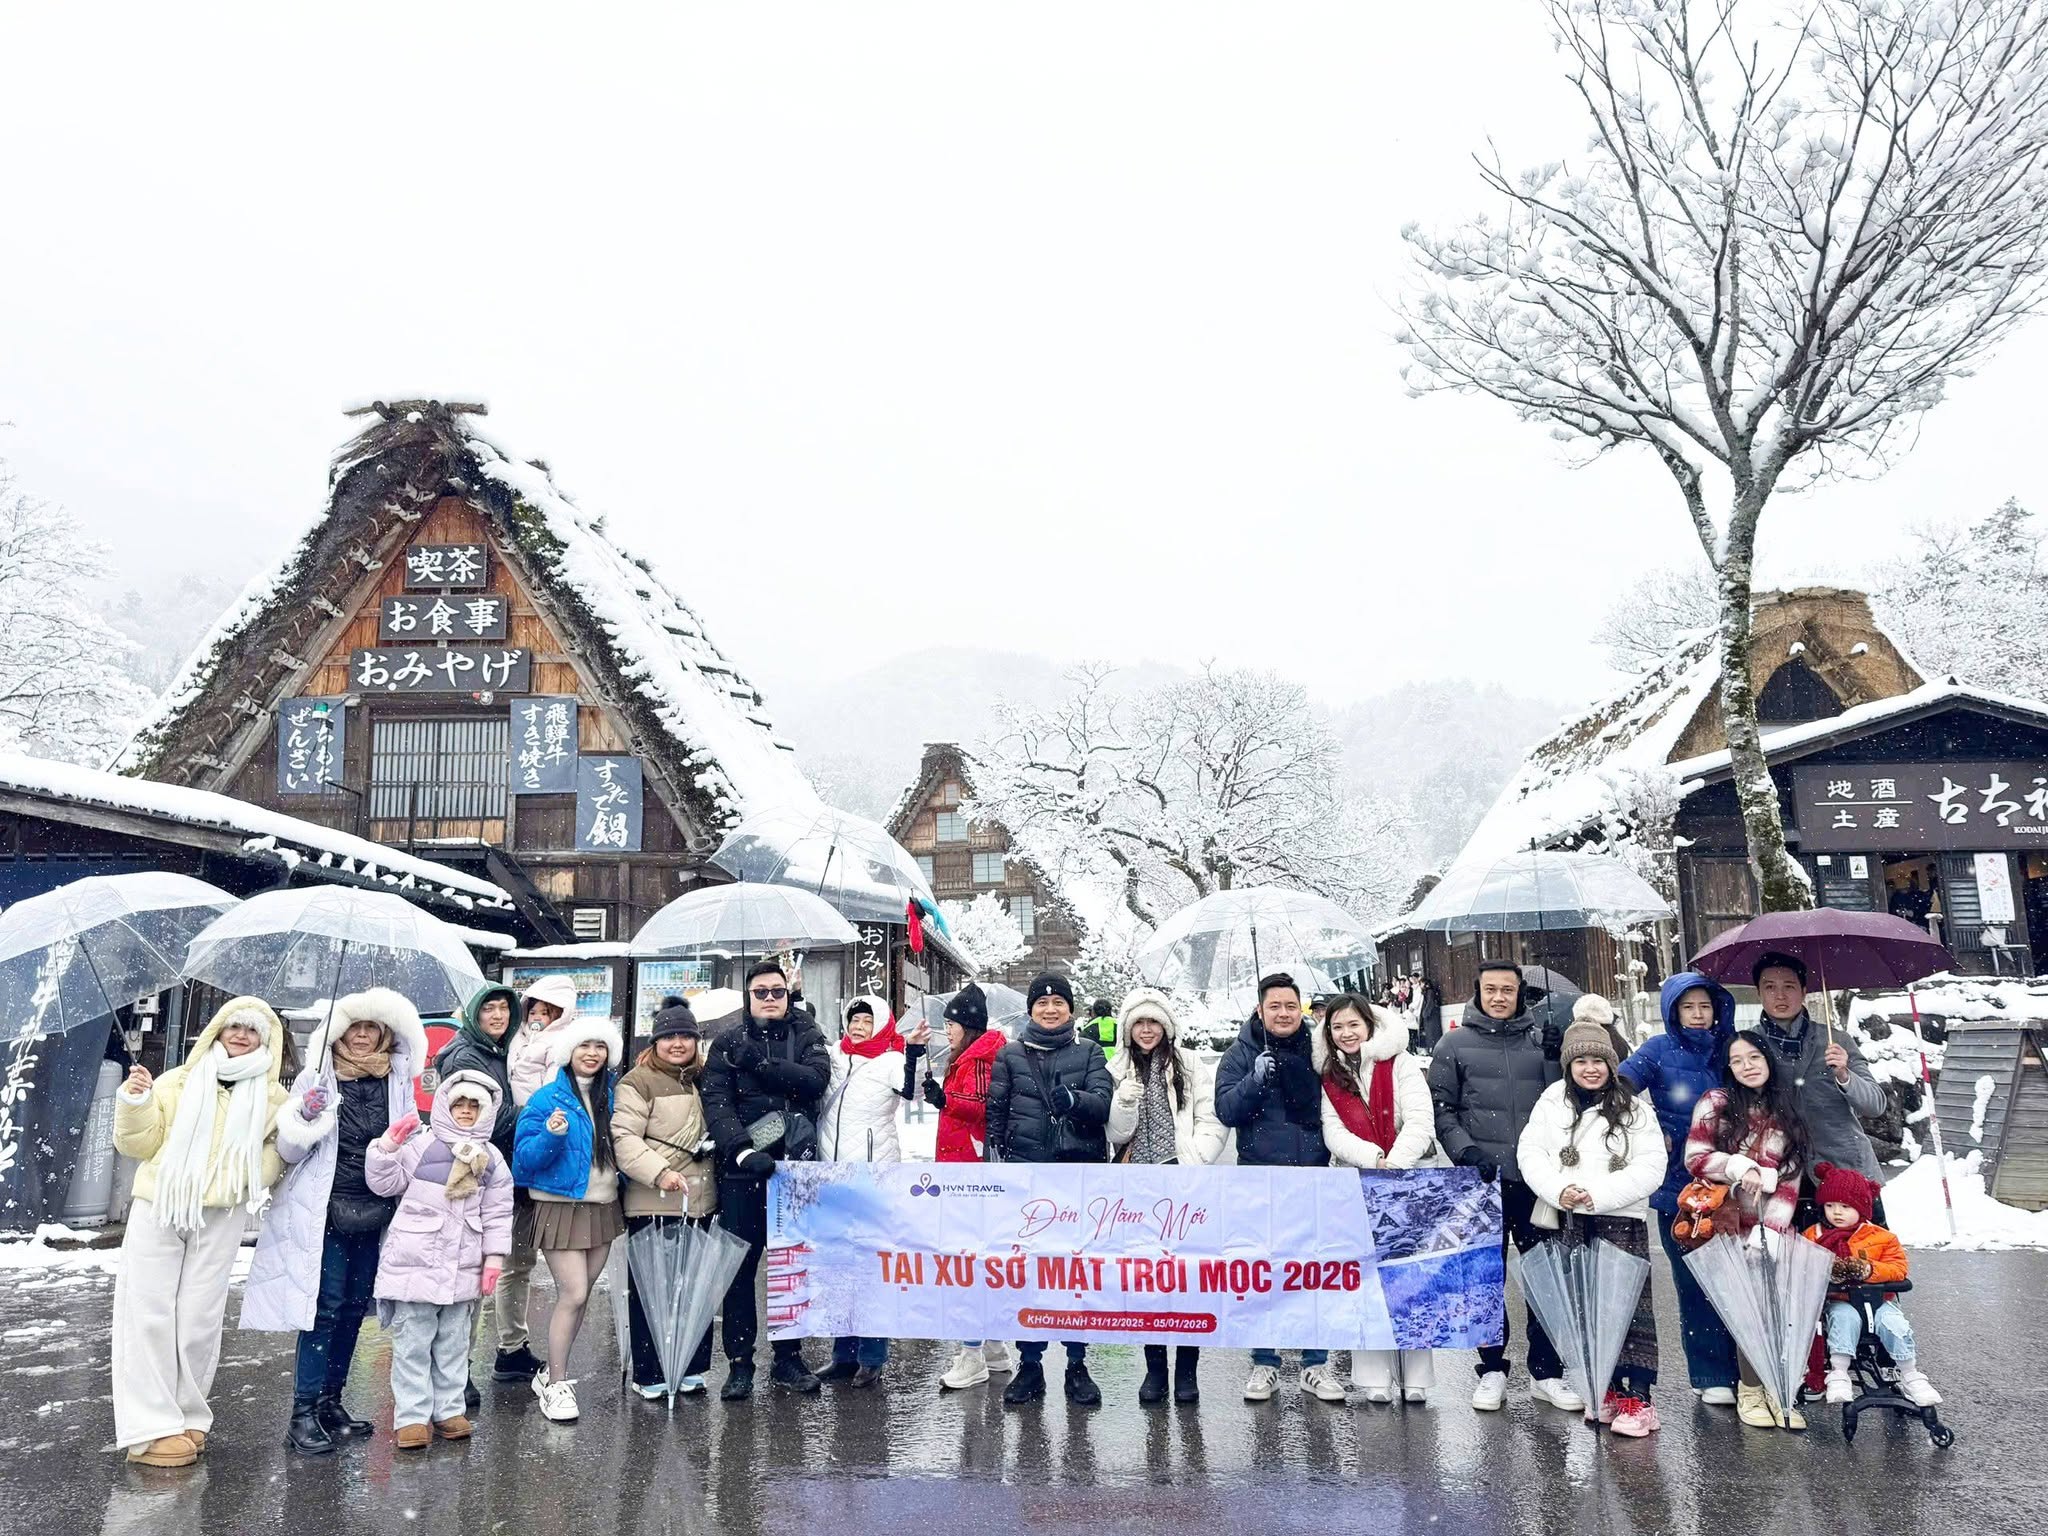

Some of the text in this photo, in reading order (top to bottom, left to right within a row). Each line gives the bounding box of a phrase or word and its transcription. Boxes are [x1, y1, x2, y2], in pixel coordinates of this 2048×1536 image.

[406, 545, 483, 583] 喫茶
[388, 598, 500, 636] お食事
[356, 650, 522, 688] おみやげ
[285, 706, 312, 790] ぜんざい
[517, 703, 546, 789] すき焼き
[543, 702, 571, 767] 飛騨牛
[585, 758, 630, 849] すったて鍋
[1827, 778, 1897, 800] 地酒
[1831, 807, 1901, 830] 土産
[942, 1184, 1006, 1193] HVN TRAVEL
[1018, 1196, 1208, 1241] Đón Năm Mới
[876, 1244, 1361, 1301] TẠI XỨ SỞ MẶT TRỜI MỌC 2026
[1090, 1317, 1145, 1329] 31/12/2025
[1153, 1318, 1208, 1329] 05/01/2026
